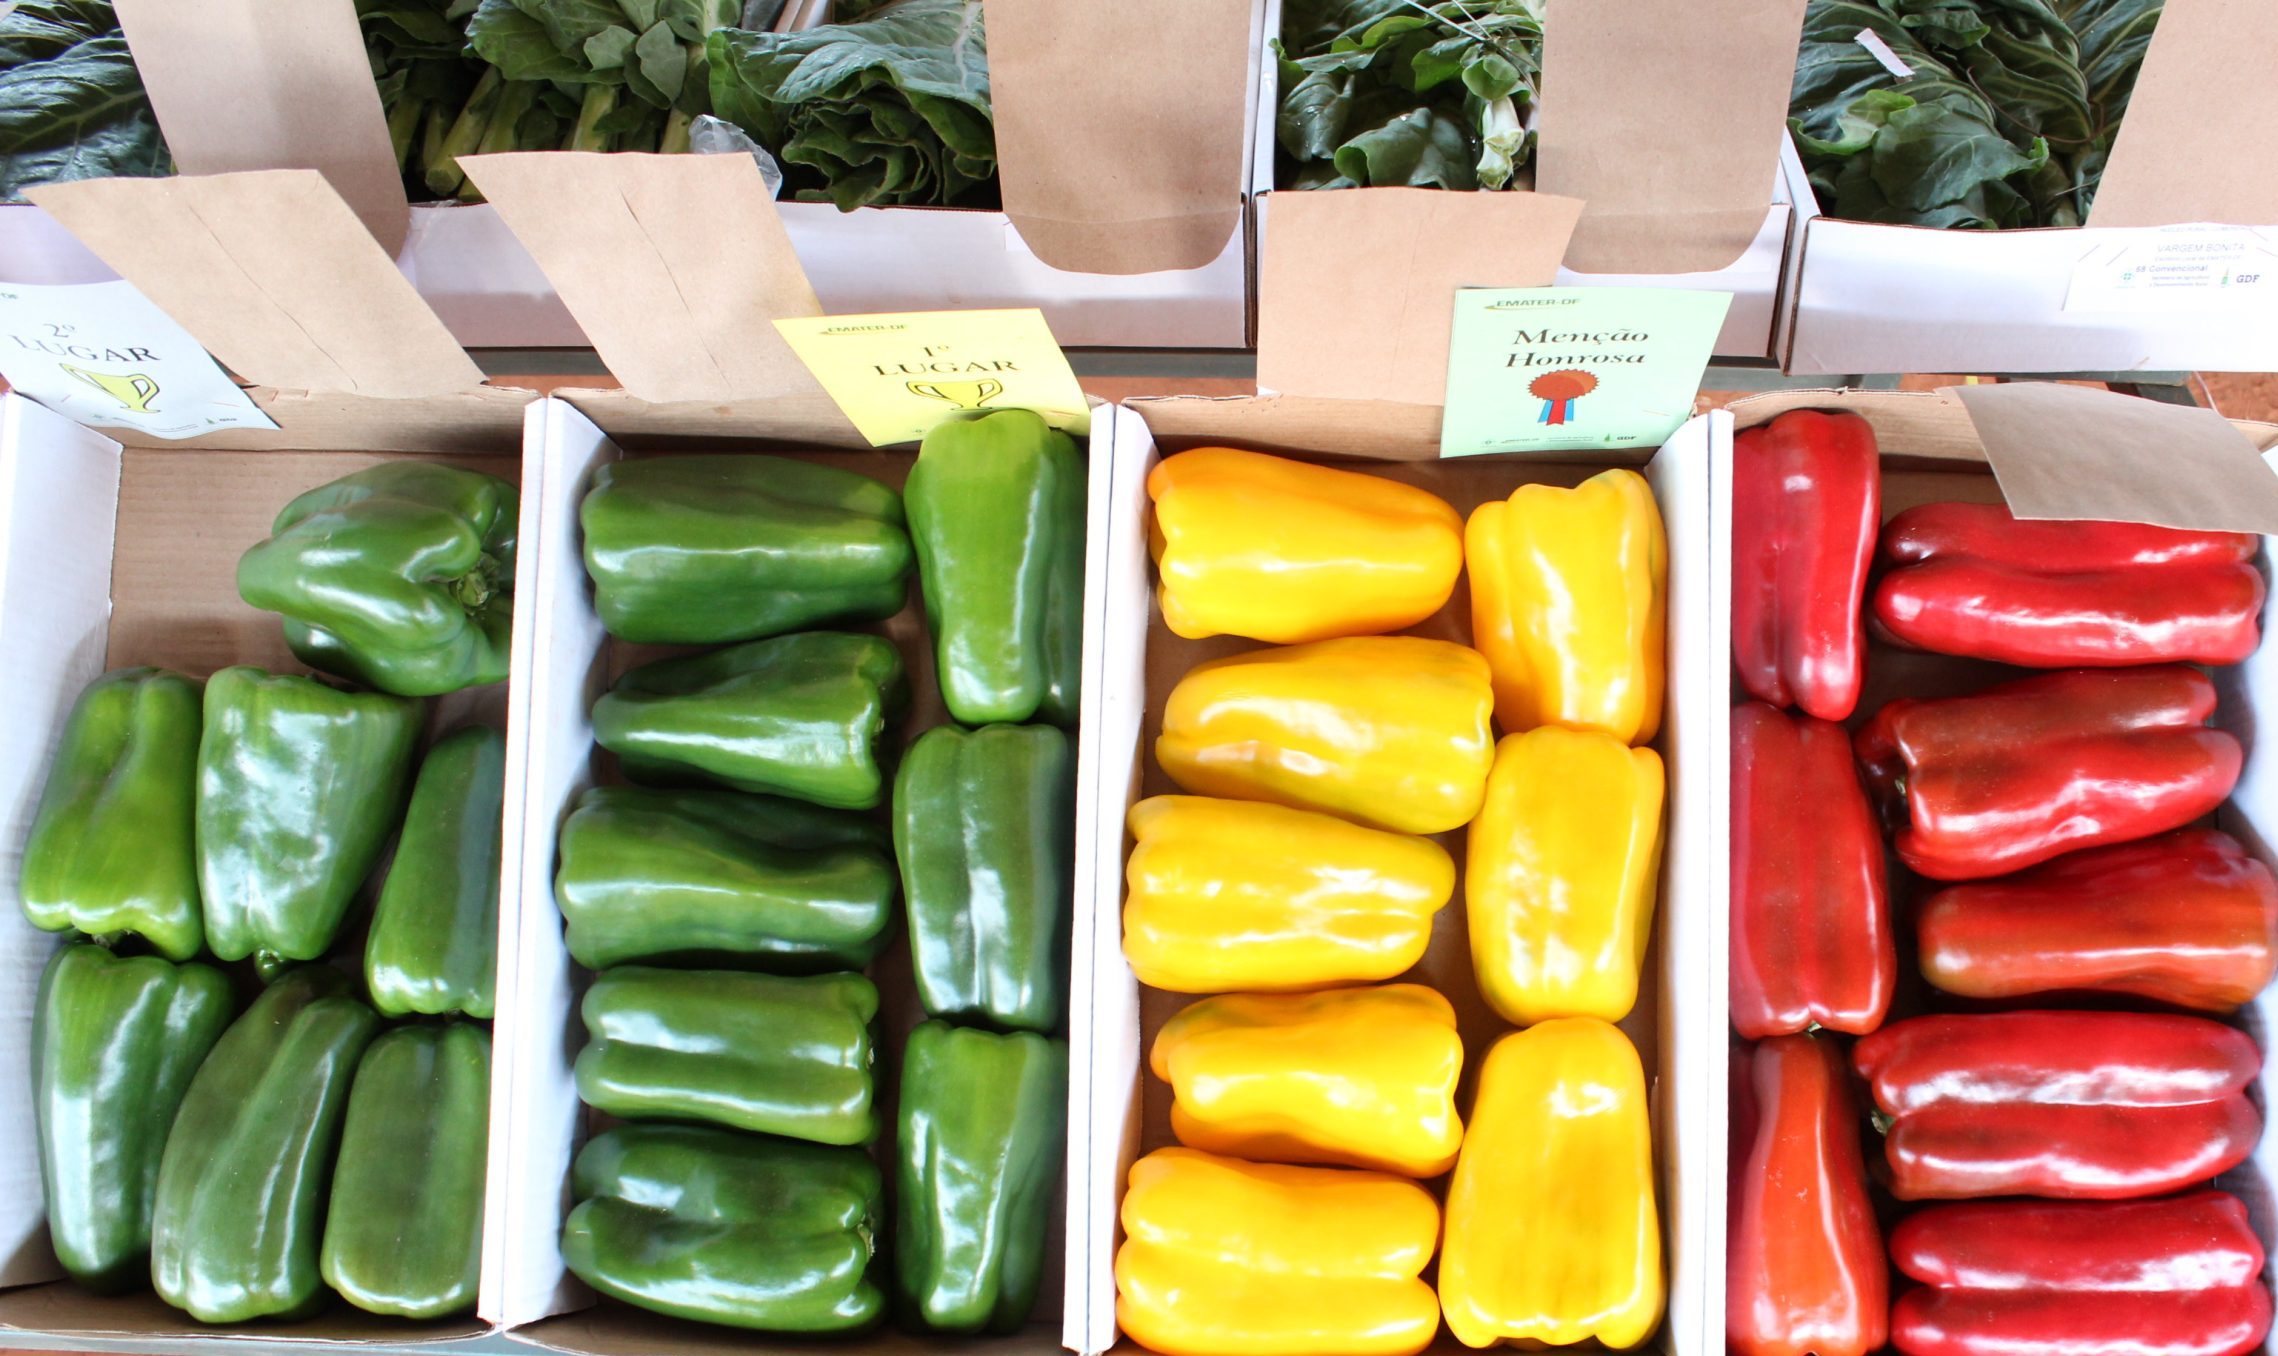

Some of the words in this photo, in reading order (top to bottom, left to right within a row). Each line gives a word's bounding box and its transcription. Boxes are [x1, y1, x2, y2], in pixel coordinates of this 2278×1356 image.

[2157, 243, 2204, 253] VARGEM
[2205, 242, 2245, 252] BONITA
[2148, 264, 2208, 273] Convencional
[2236, 274, 2260, 283] GDF
[1496, 299, 1580, 307] EMATER-DF
[1512, 328, 1649, 346] Menção
[8, 334, 162, 362] LUGAR
[1505, 352, 1646, 368] Honrosa
[873, 360, 1021, 376] LUGAR
